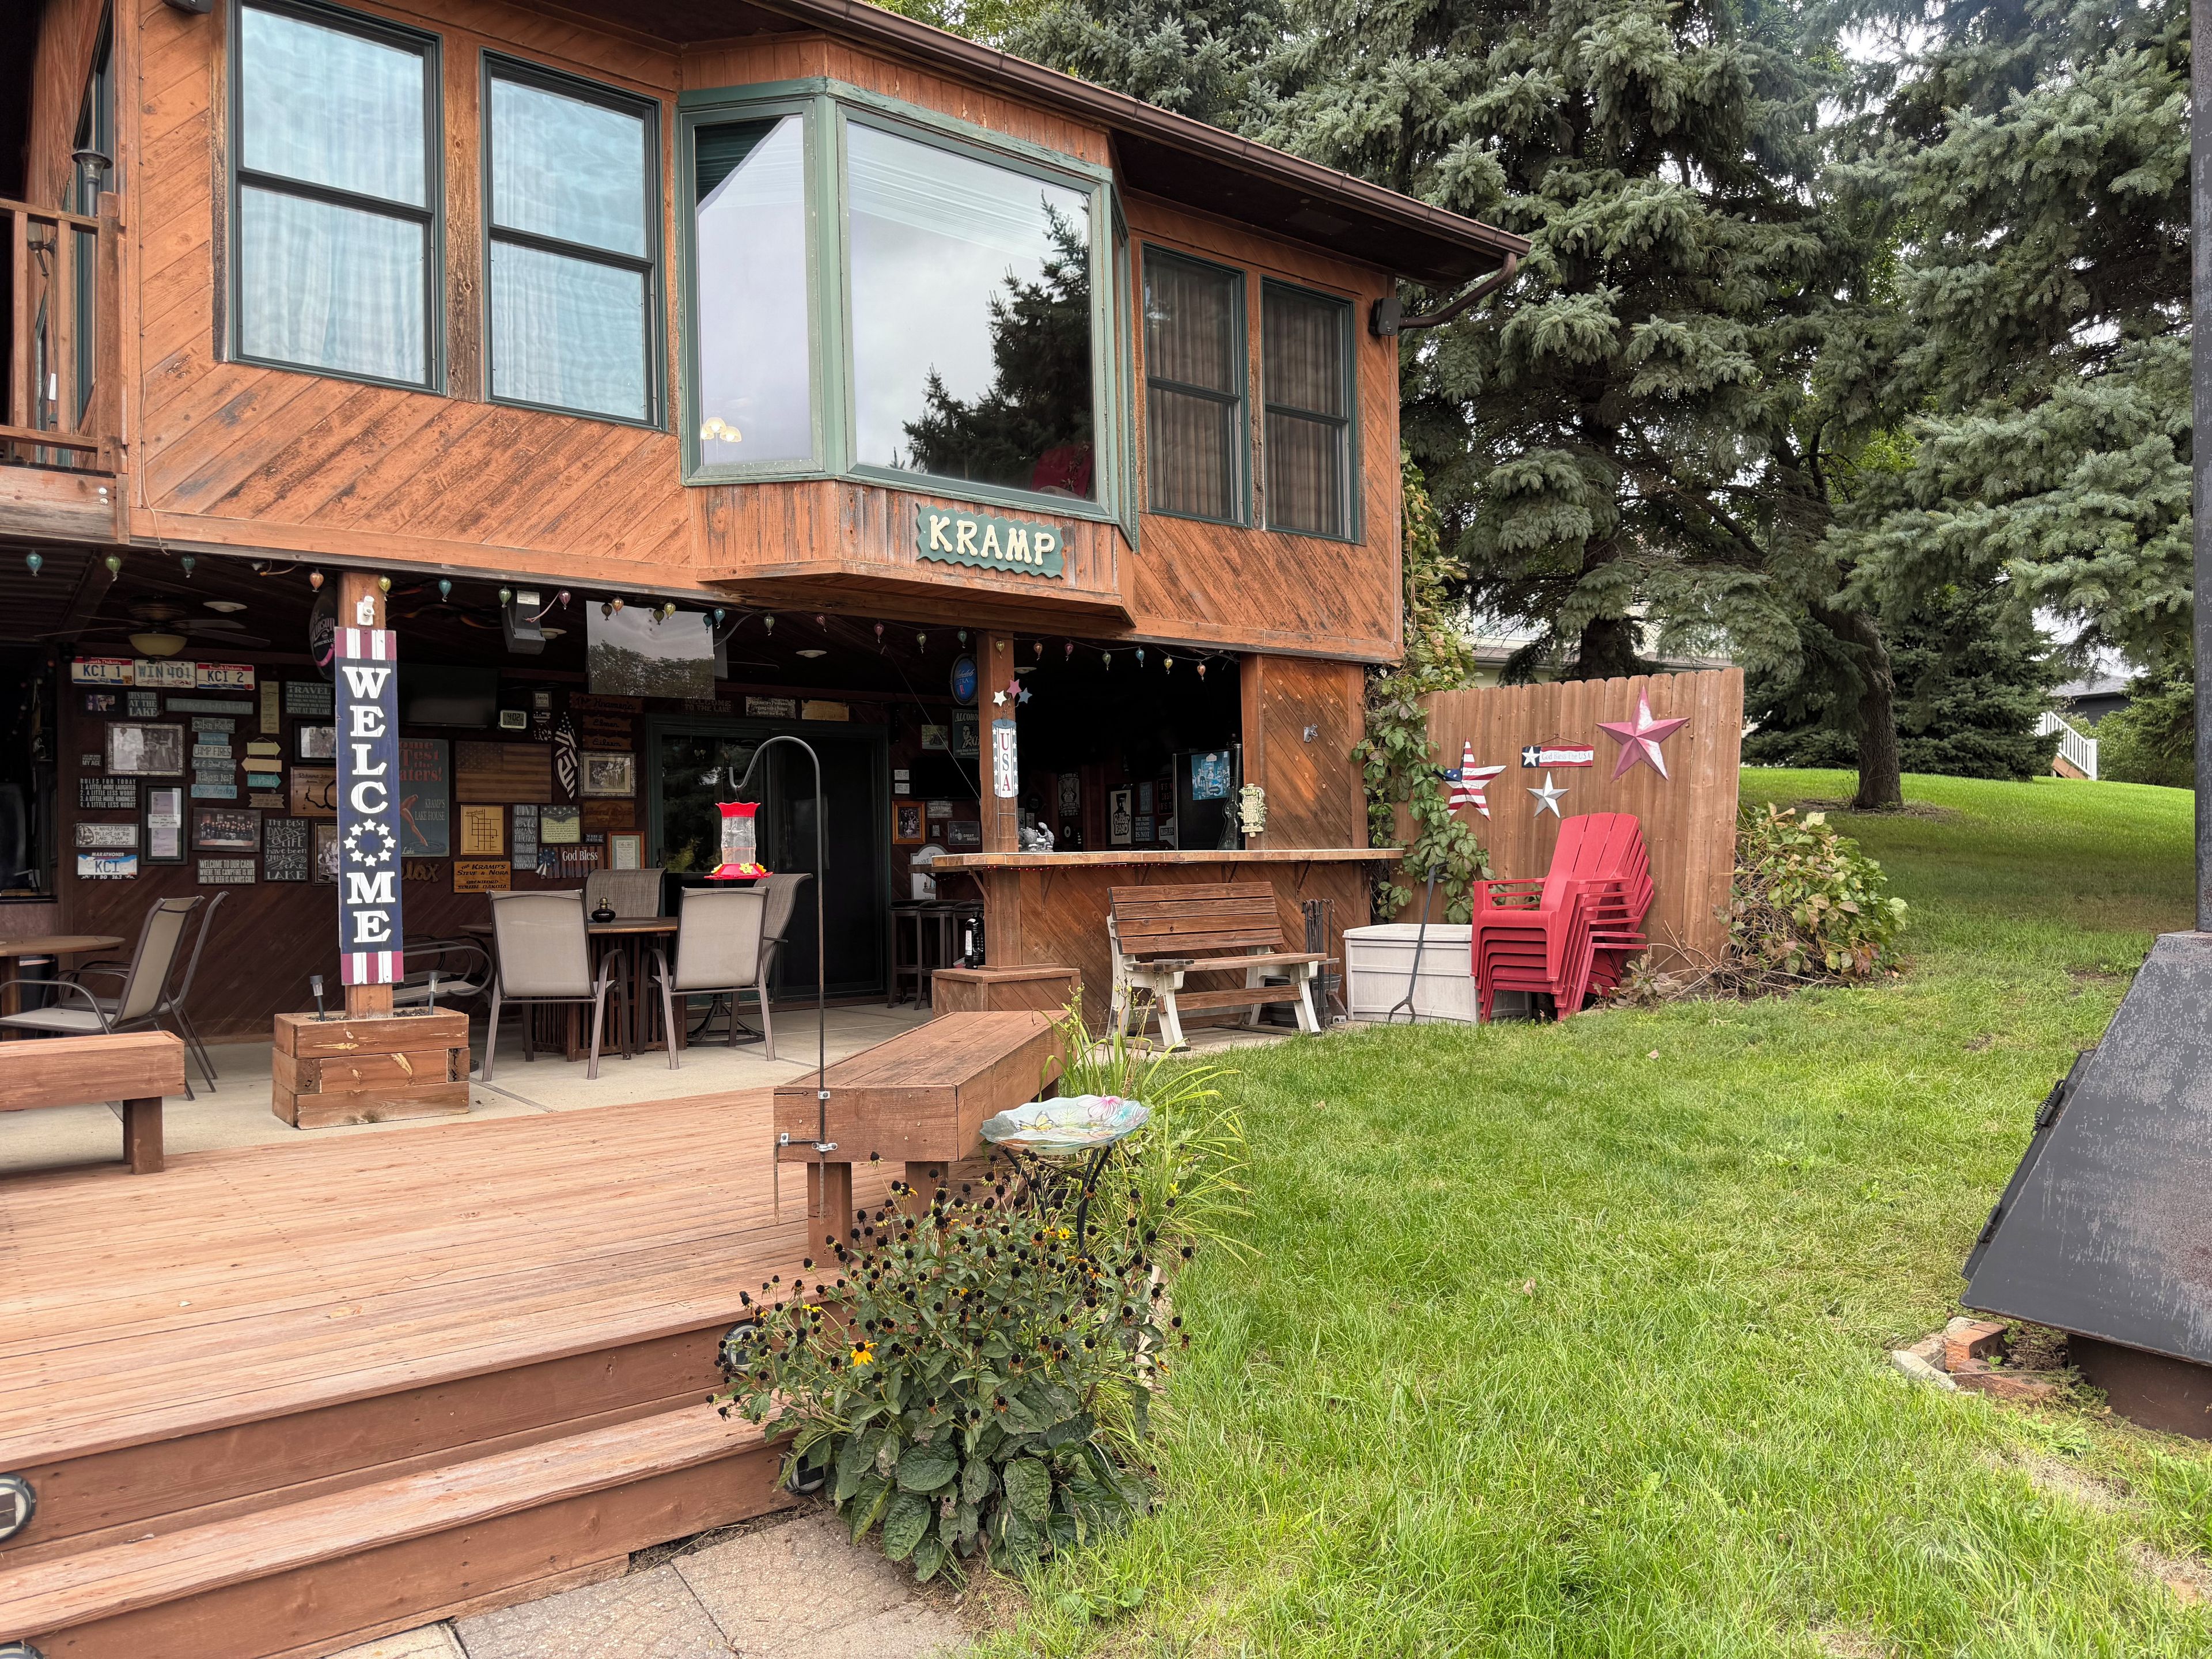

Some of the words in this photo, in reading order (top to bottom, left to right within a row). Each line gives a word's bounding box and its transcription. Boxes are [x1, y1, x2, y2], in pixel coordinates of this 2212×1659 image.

[929, 514, 1055, 566] KRAMP
[83, 664, 105, 677] KCI
[116, 665, 120, 677] 1
[138, 665, 163, 678] WIN
[167, 666, 190, 679] 401
[207, 670, 228, 682] KCI
[237, 672, 244, 683] 2
[287, 686, 331, 695] TRAVEL
[129, 707, 157, 717] LAKE
[955, 713, 978, 722] ALCOHO
[193, 718, 212, 730] Cabin
[215, 719, 234, 731] Rules
[194, 745, 211, 756] CAMP
[213, 746, 231, 756] FIRES
[399, 741, 433, 749] ome
[400, 749, 439, 767] Test
[1541, 752, 1552, 760] God
[1554, 752, 1566, 760] Bless
[1000, 733, 1011, 791] USA
[198, 772, 212, 782] Take
[399, 766, 442, 782] aters!
[249, 776, 276, 785] cocktails
[213, 786, 222, 794] the
[223, 787, 236, 796] day
[342, 666, 396, 944] WELCOME
[415, 810, 428, 821] LAKE
[428, 810, 445, 821] HOUSE
[286, 819, 305, 827] BEST
[267, 827, 293, 836] DAYS
[282, 836, 304, 847] LIFE
[402, 846, 415, 855] Lake
[562, 850, 577, 861] God
[579, 850, 598, 861] Bless
[95, 861, 120, 873] KCI
[199, 860, 222, 868] WELCOME
[224, 860, 229, 868] TO
[230, 860, 240, 868] OUR
[240, 860, 255, 869] CABIN
[267, 870, 305, 880] LAKE
[402, 860, 440, 882] lax
